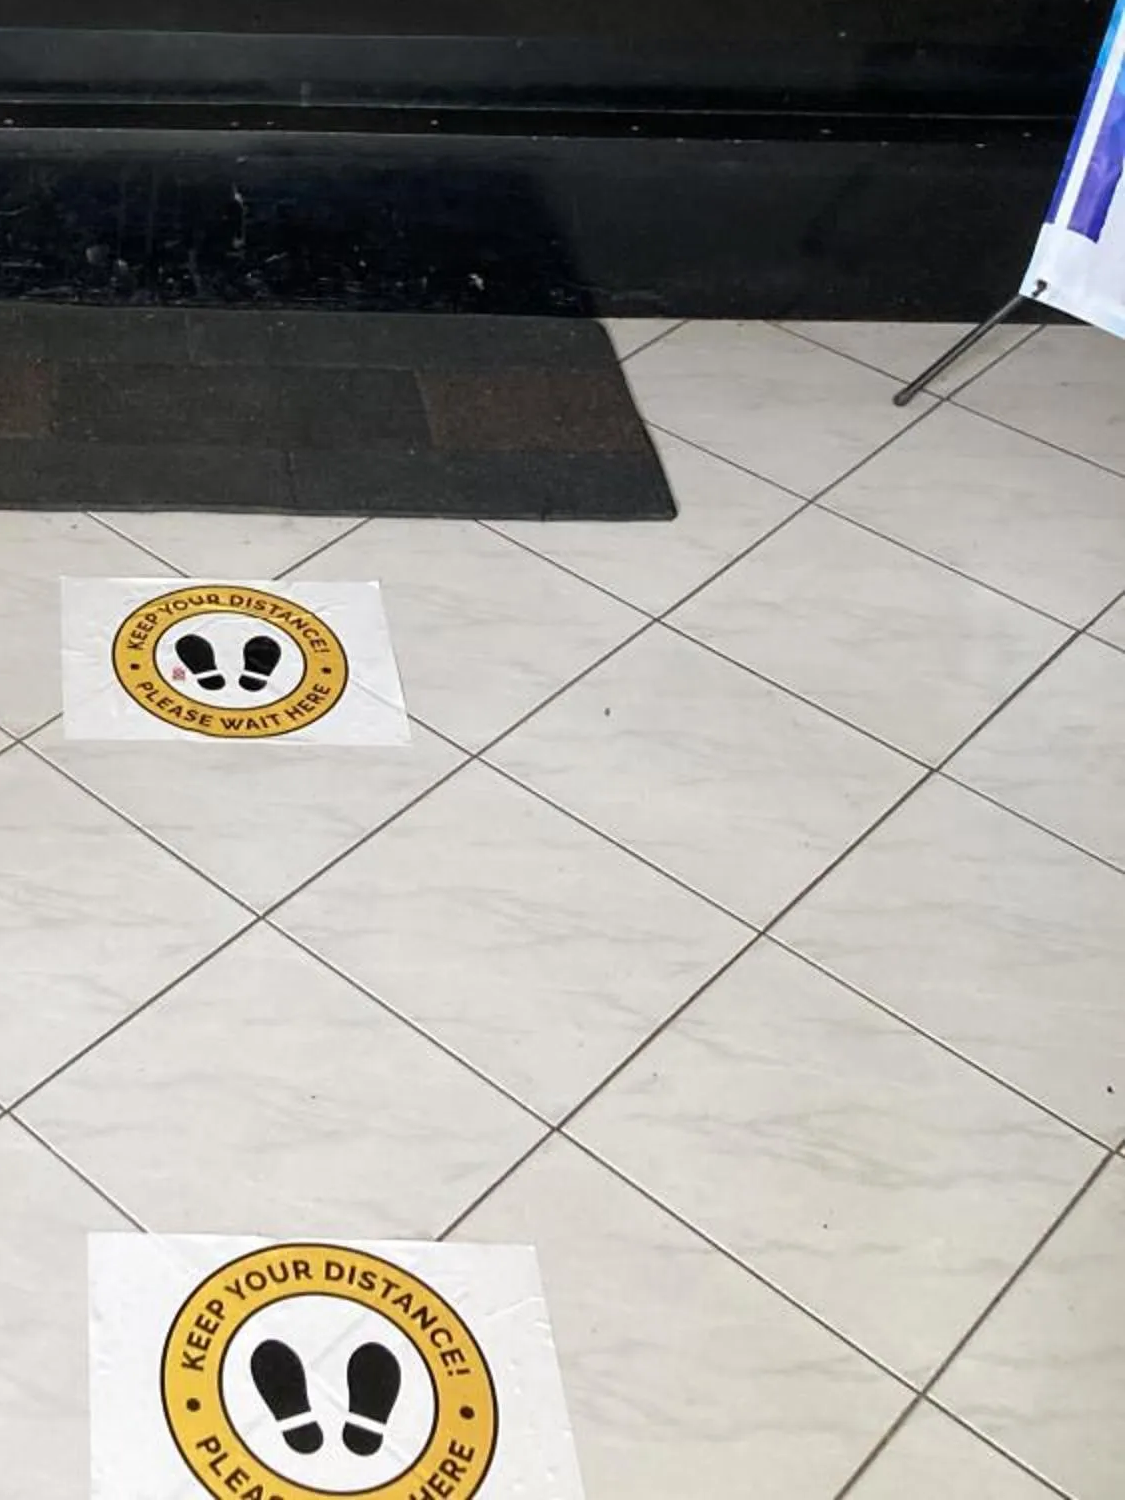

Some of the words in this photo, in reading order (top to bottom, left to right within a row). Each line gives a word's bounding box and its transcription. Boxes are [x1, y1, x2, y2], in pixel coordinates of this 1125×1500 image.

[126, 612, 159, 651] KEEP
[158, 593, 221, 618] YOUR
[229, 594, 331, 654] DISTANCE!
[136, 681, 214, 728] PLEASE
[220, 712, 282, 731] WAIT
[287, 683, 332, 722] HERE
[181, 1299, 228, 1372] KEEP
[224, 1259, 313, 1300] YOUR
[324, 1260, 471, 1377] DISTANCE!
[196, 1435, 285, 1500] PLEA
